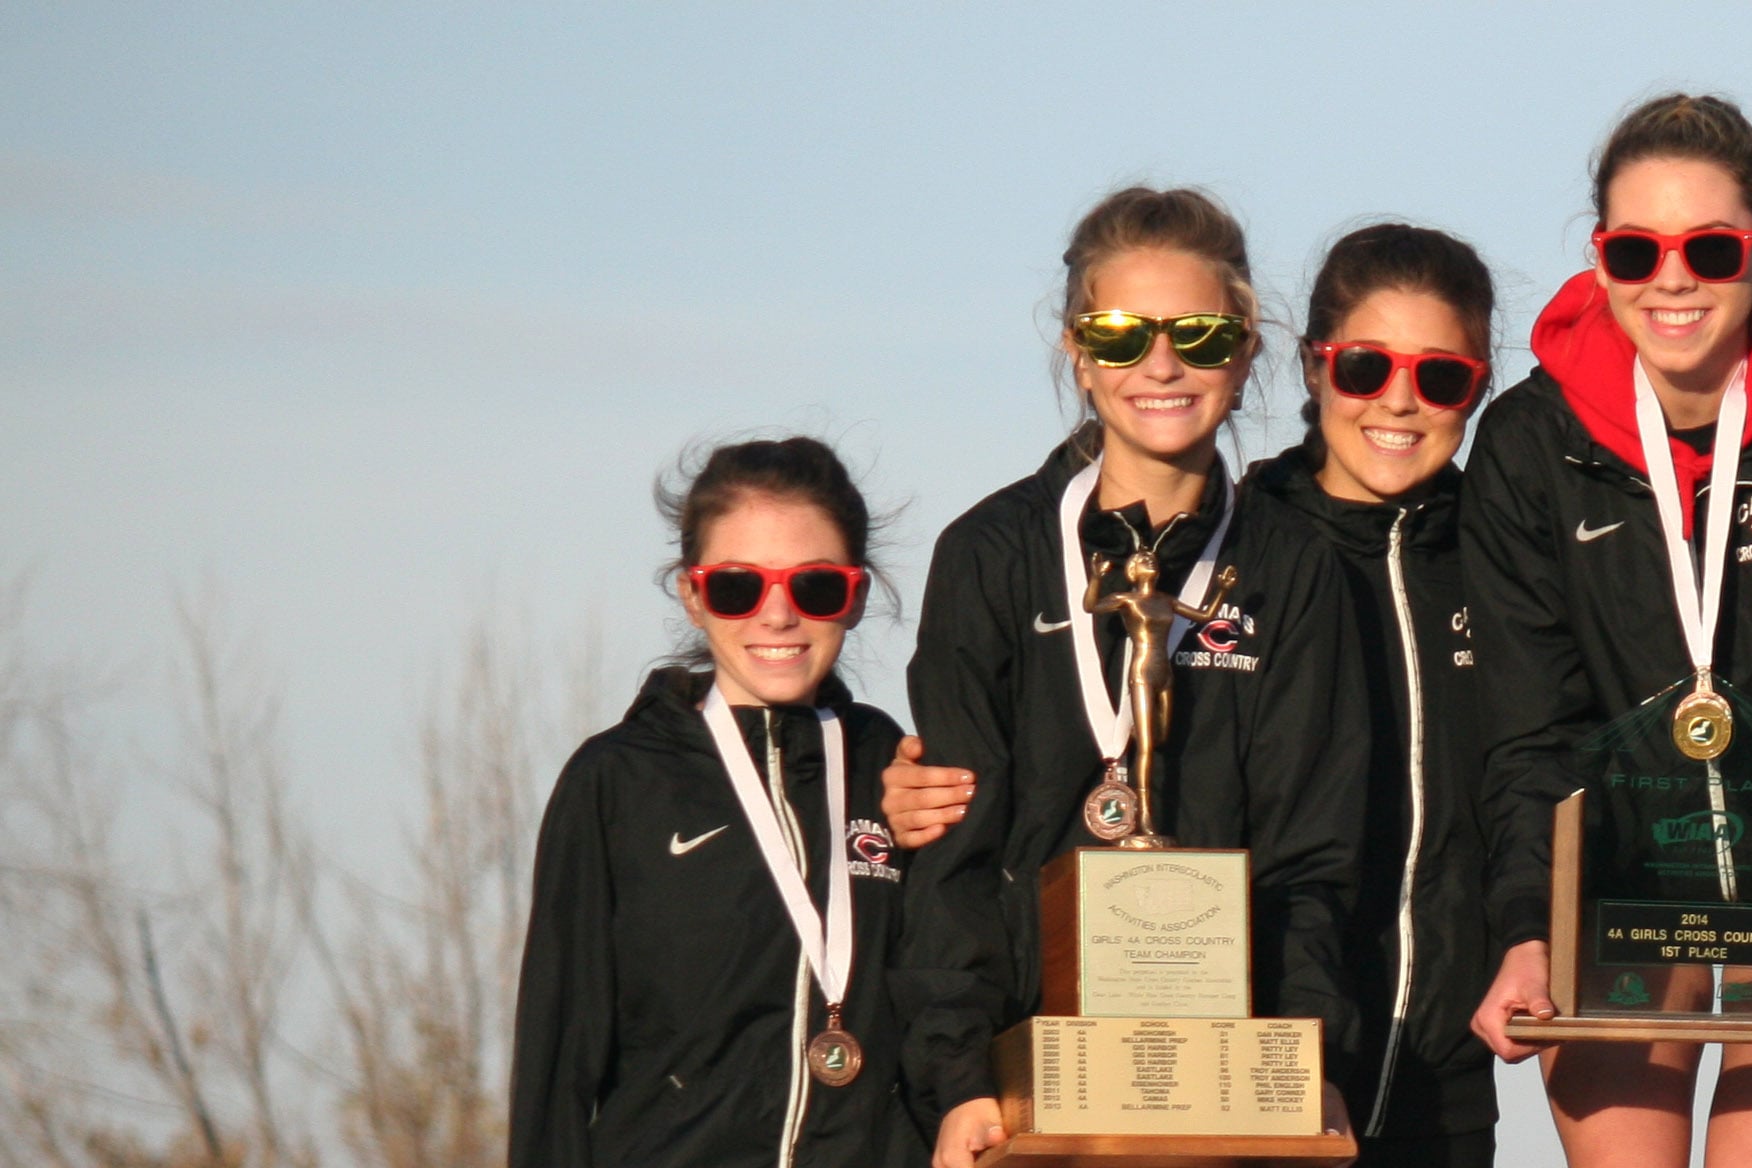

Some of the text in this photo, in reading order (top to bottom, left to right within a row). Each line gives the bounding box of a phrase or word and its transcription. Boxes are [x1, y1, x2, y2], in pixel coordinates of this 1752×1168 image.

[1175, 651, 1260, 671] CROSS COUNTRY
[1611, 774, 1689, 791] FIRST
[1666, 819, 1729, 841] WIAA
[1103, 864, 1155, 891] WASHINGTON
[1107, 904, 1222, 932] ACTIVITIES ASSOCIATION
[1681, 914, 1709, 926] 2014
[1127, 936, 1140, 945] 4A
[1145, 936, 1182, 945] CROSS
[1185, 936, 1236, 946] COUNTRY
[1607, 928, 1623, 940] 4A
[1630, 928, 1668, 941] GIRLS
[1674, 930, 1717, 942] CROSS
[1124, 950, 1207, 960] TEAM CHAMPION
[1661, 946, 1728, 959] 1ST PLACE
